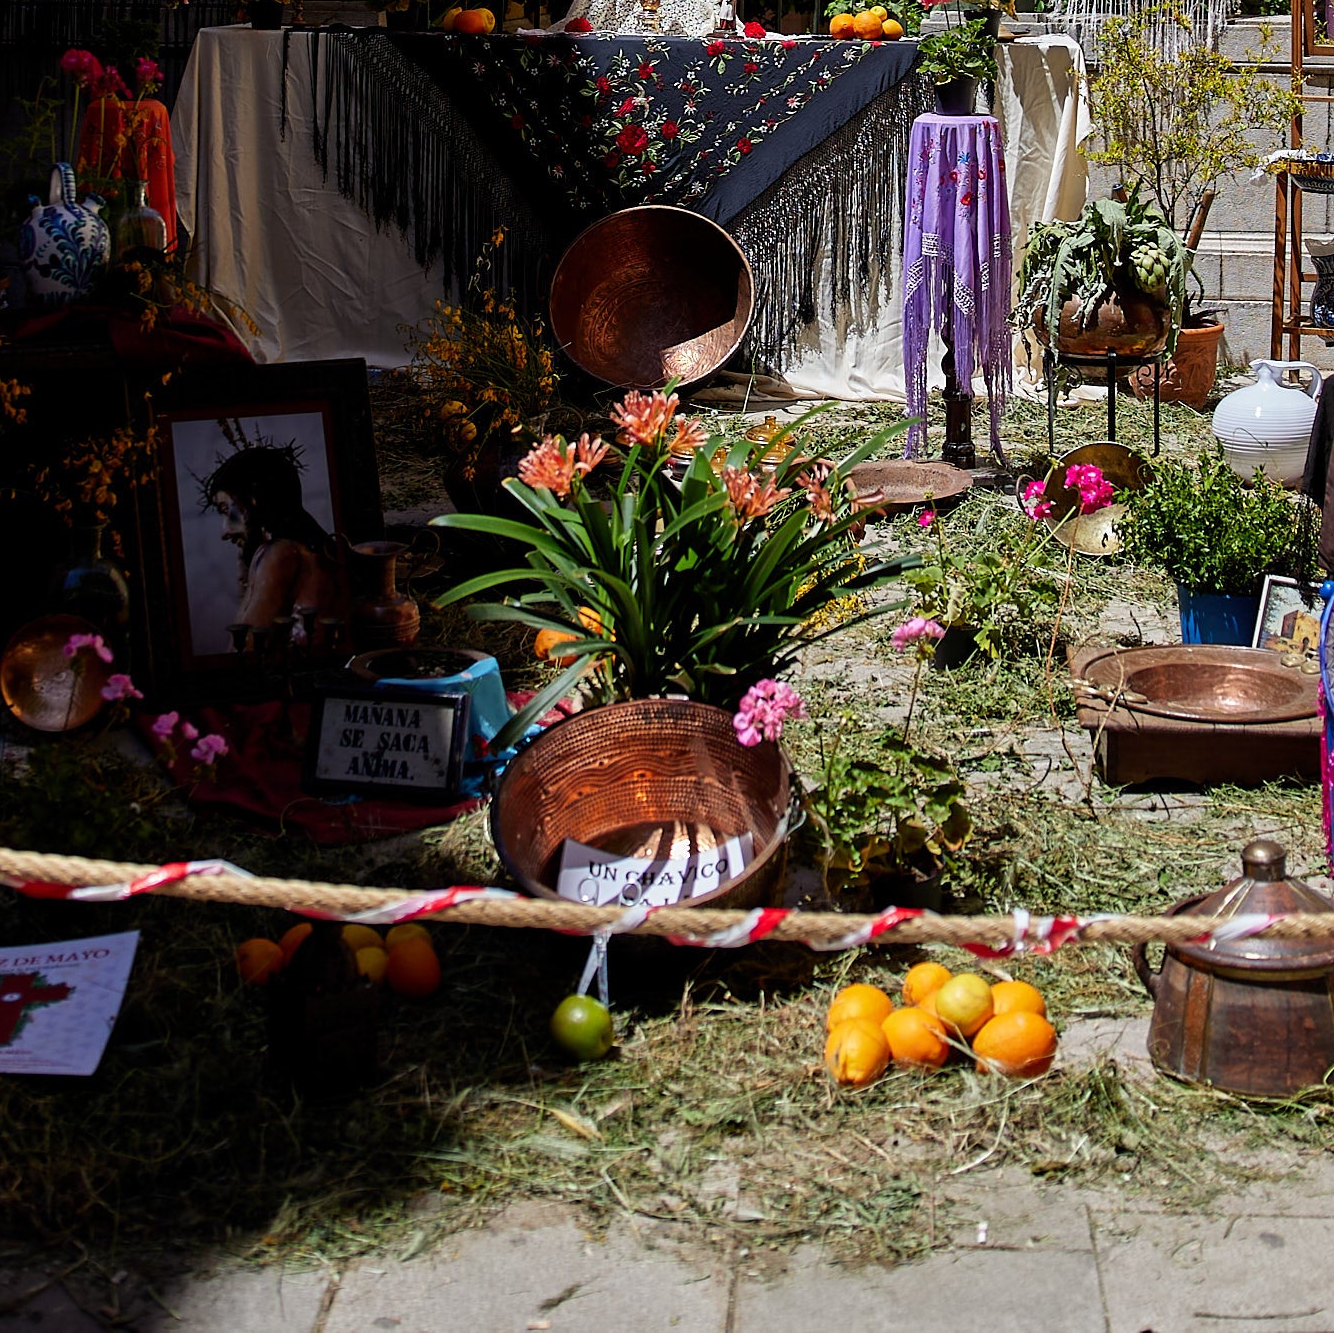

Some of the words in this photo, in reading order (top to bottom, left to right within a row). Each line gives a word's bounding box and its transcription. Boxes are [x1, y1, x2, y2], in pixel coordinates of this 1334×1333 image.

[339, 728, 365, 748] SE
[377, 731, 429, 753] SACA
[589, 861, 618, 881] UN
[626, 859, 727, 885] CHAVICO
[13, 956, 40, 966] DE
[45, 949, 110, 964] MAYO
